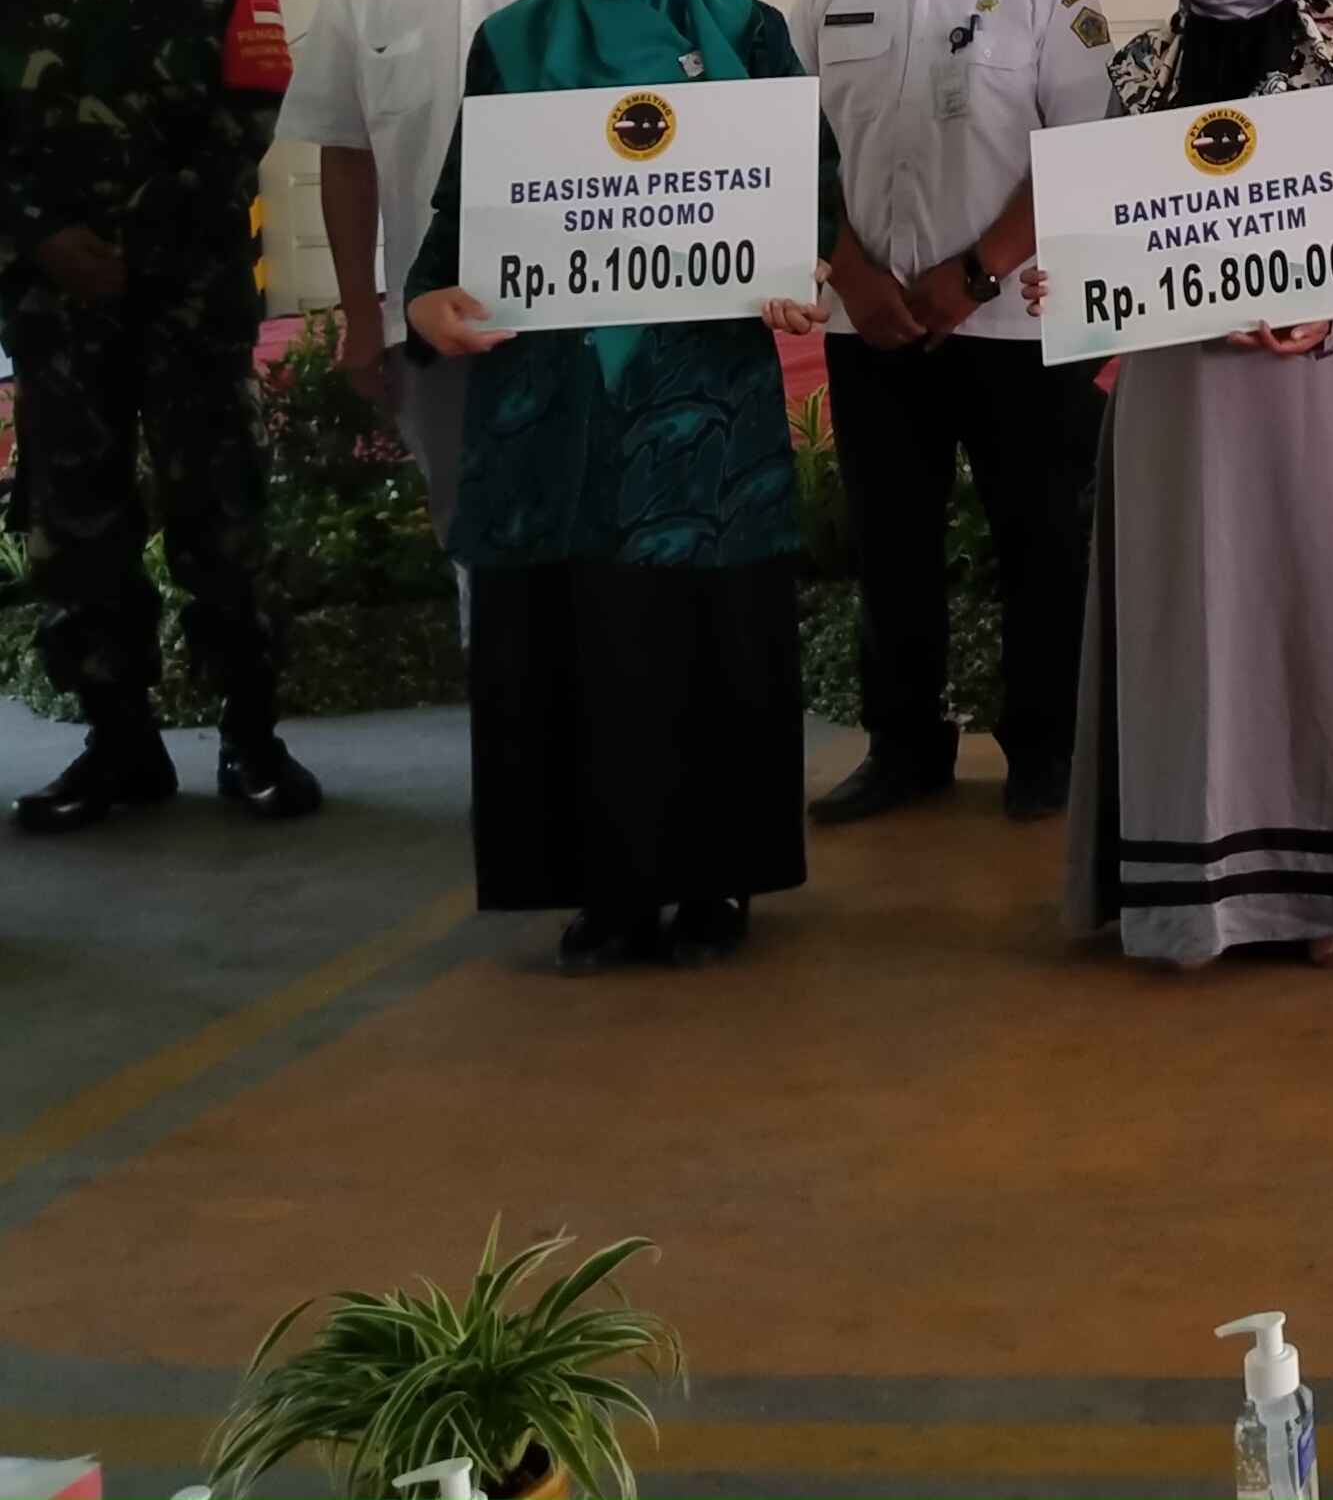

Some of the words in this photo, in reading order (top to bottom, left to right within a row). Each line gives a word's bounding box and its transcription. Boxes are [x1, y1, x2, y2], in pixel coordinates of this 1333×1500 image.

[511, 175, 639, 204] BEASISWA
[648, 167, 771, 195] PRESTASI
[1115, 186, 1239, 225] BANTUAN
[1249, 171, 1333, 204] BERAS
[564, 208, 613, 231] SDN
[623, 202, 714, 228] ROOMO
[1147, 220, 1220, 251] ANAK
[1227, 207, 1307, 239] YATIM
[501, 255, 555, 308] Rp.
[569, 240, 755, 295] 8.100.000
[1085, 279, 1145, 331] Rp.
